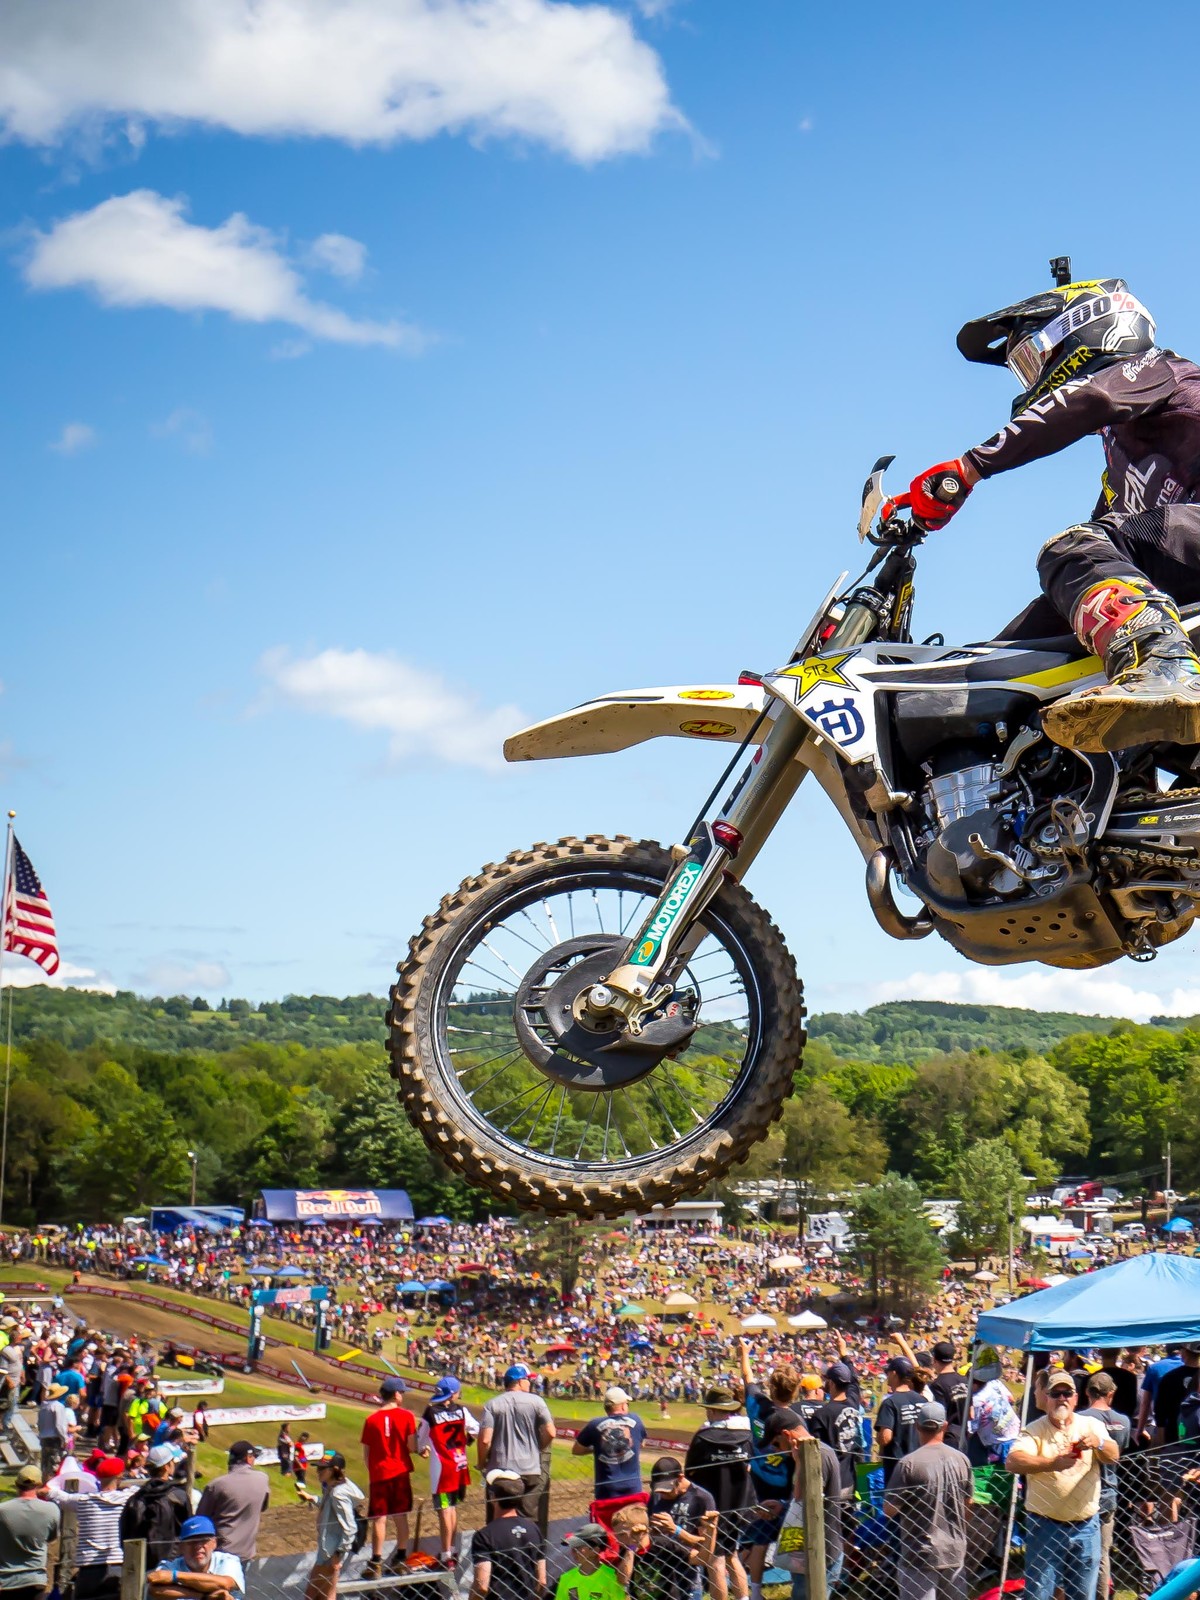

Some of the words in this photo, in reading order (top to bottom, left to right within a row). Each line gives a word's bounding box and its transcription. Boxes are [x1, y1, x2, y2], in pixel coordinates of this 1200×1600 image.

[1056, 293, 1135, 338] 100%
[682, 722, 736, 734] FMF
[646, 864, 700, 942] MOTOREX
[299, 1200, 339, 1214] Red
[343, 1200, 380, 1214] Bull
